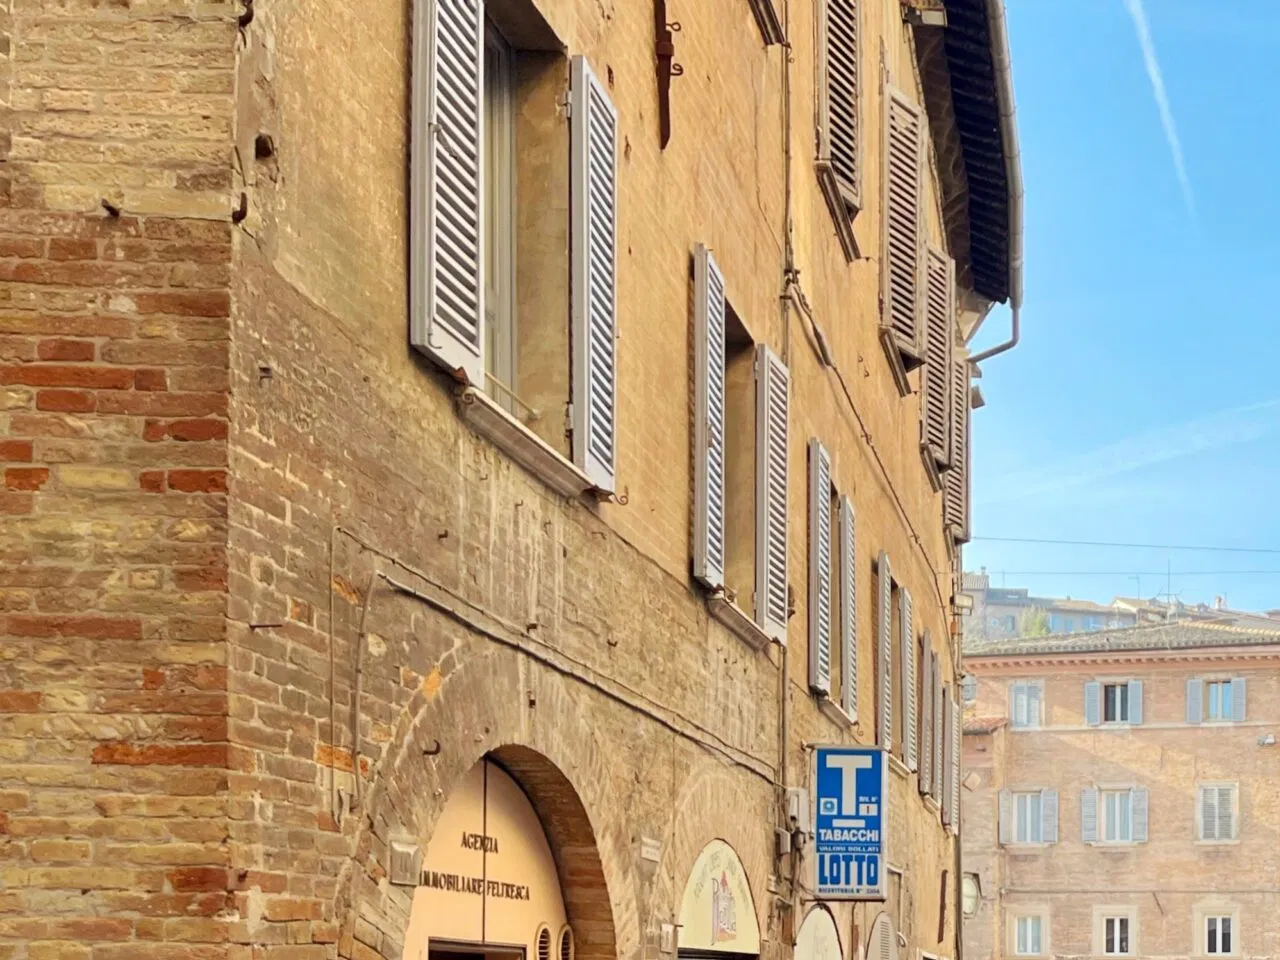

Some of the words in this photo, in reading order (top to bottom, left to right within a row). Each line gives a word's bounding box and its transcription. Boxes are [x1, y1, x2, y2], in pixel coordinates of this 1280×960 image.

[826, 754, 872, 816] T
[461, 831, 498, 854] AGENZIA
[819, 829, 879, 842] TABACCHI
[419, 870, 484, 896] IMMOBILIARE
[486, 880, 530, 900] FELTRESCA
[818, 854, 879, 886] LOTTO
